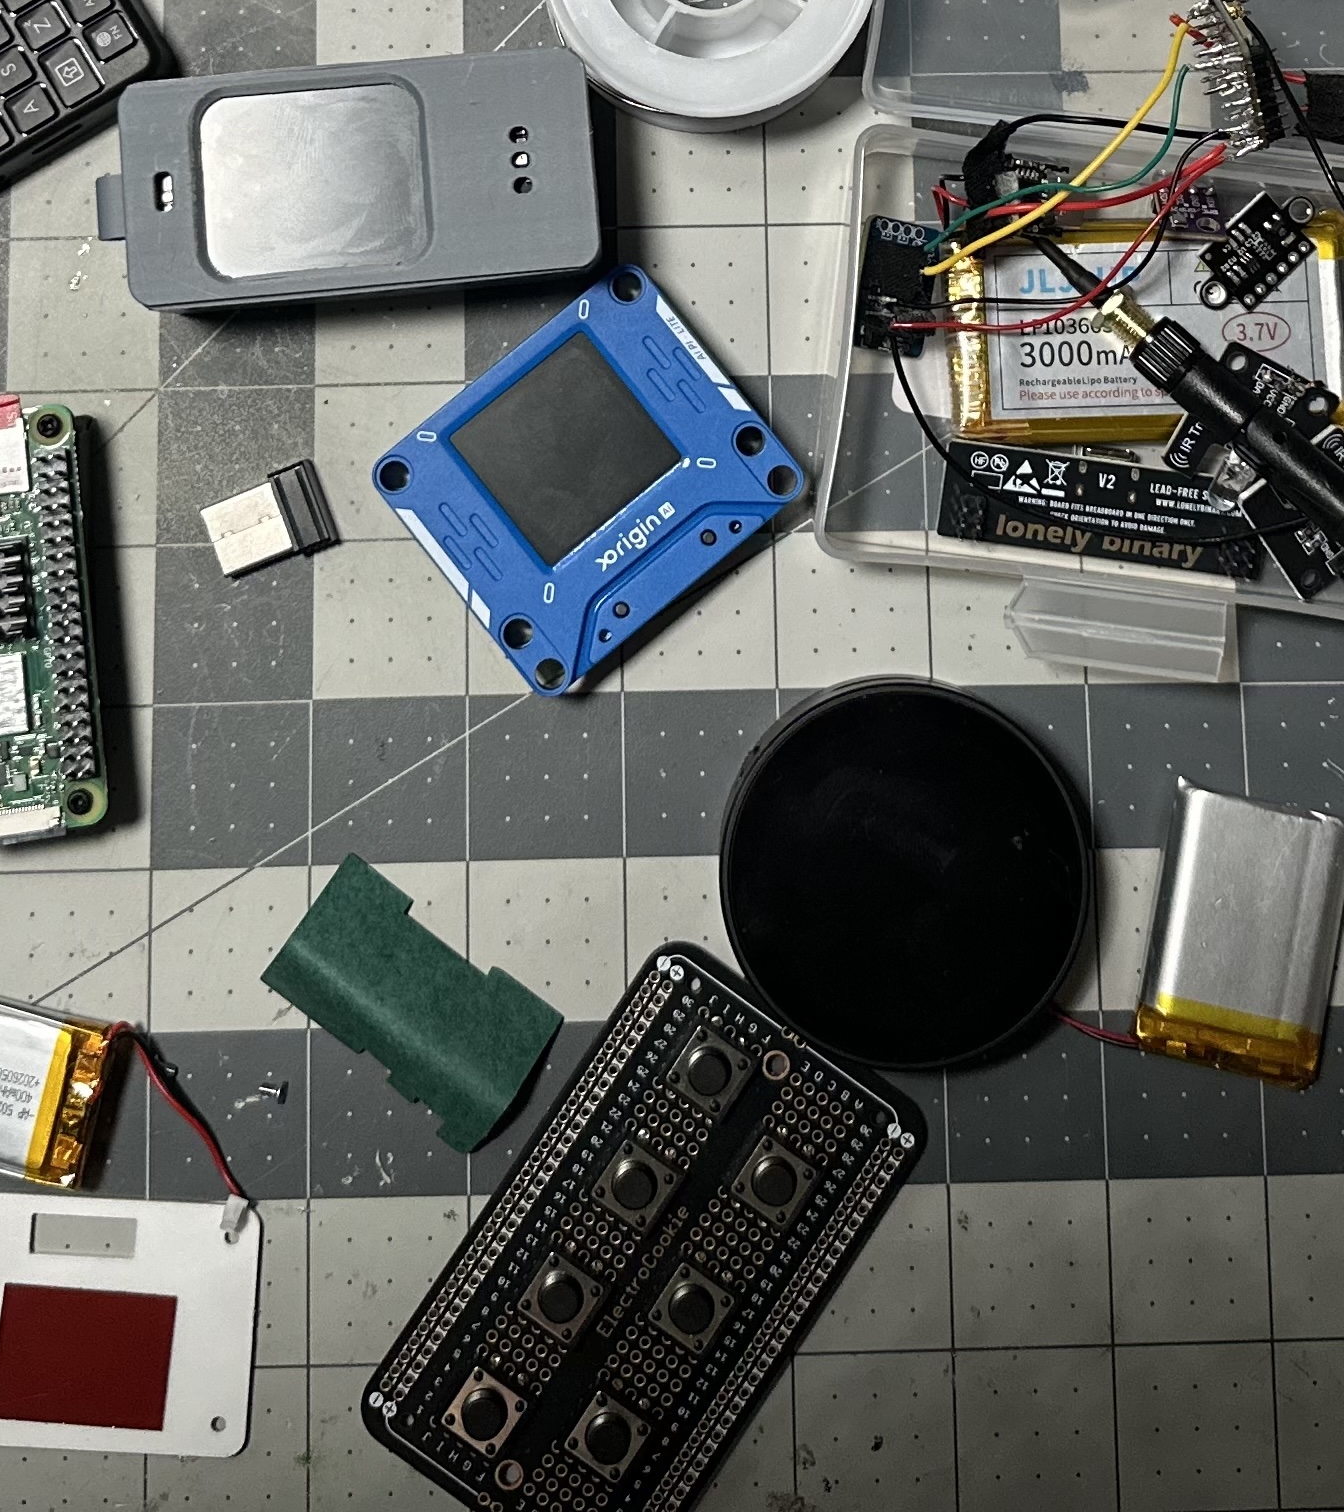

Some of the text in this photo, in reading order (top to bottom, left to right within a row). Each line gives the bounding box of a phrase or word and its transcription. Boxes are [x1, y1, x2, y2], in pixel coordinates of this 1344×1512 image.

[1236, 322, 1278, 342] 3.7V
[1103, 376, 1138, 386] Battery
[1019, 389, 1138, 403] Please use according
[1098, 472, 1117, 489] V2
[1150, 482, 1200, 500] LEAD-FREE
[996, 514, 1091, 554] lonely
[595, 1203, 691, 1339] ElectroCookie
